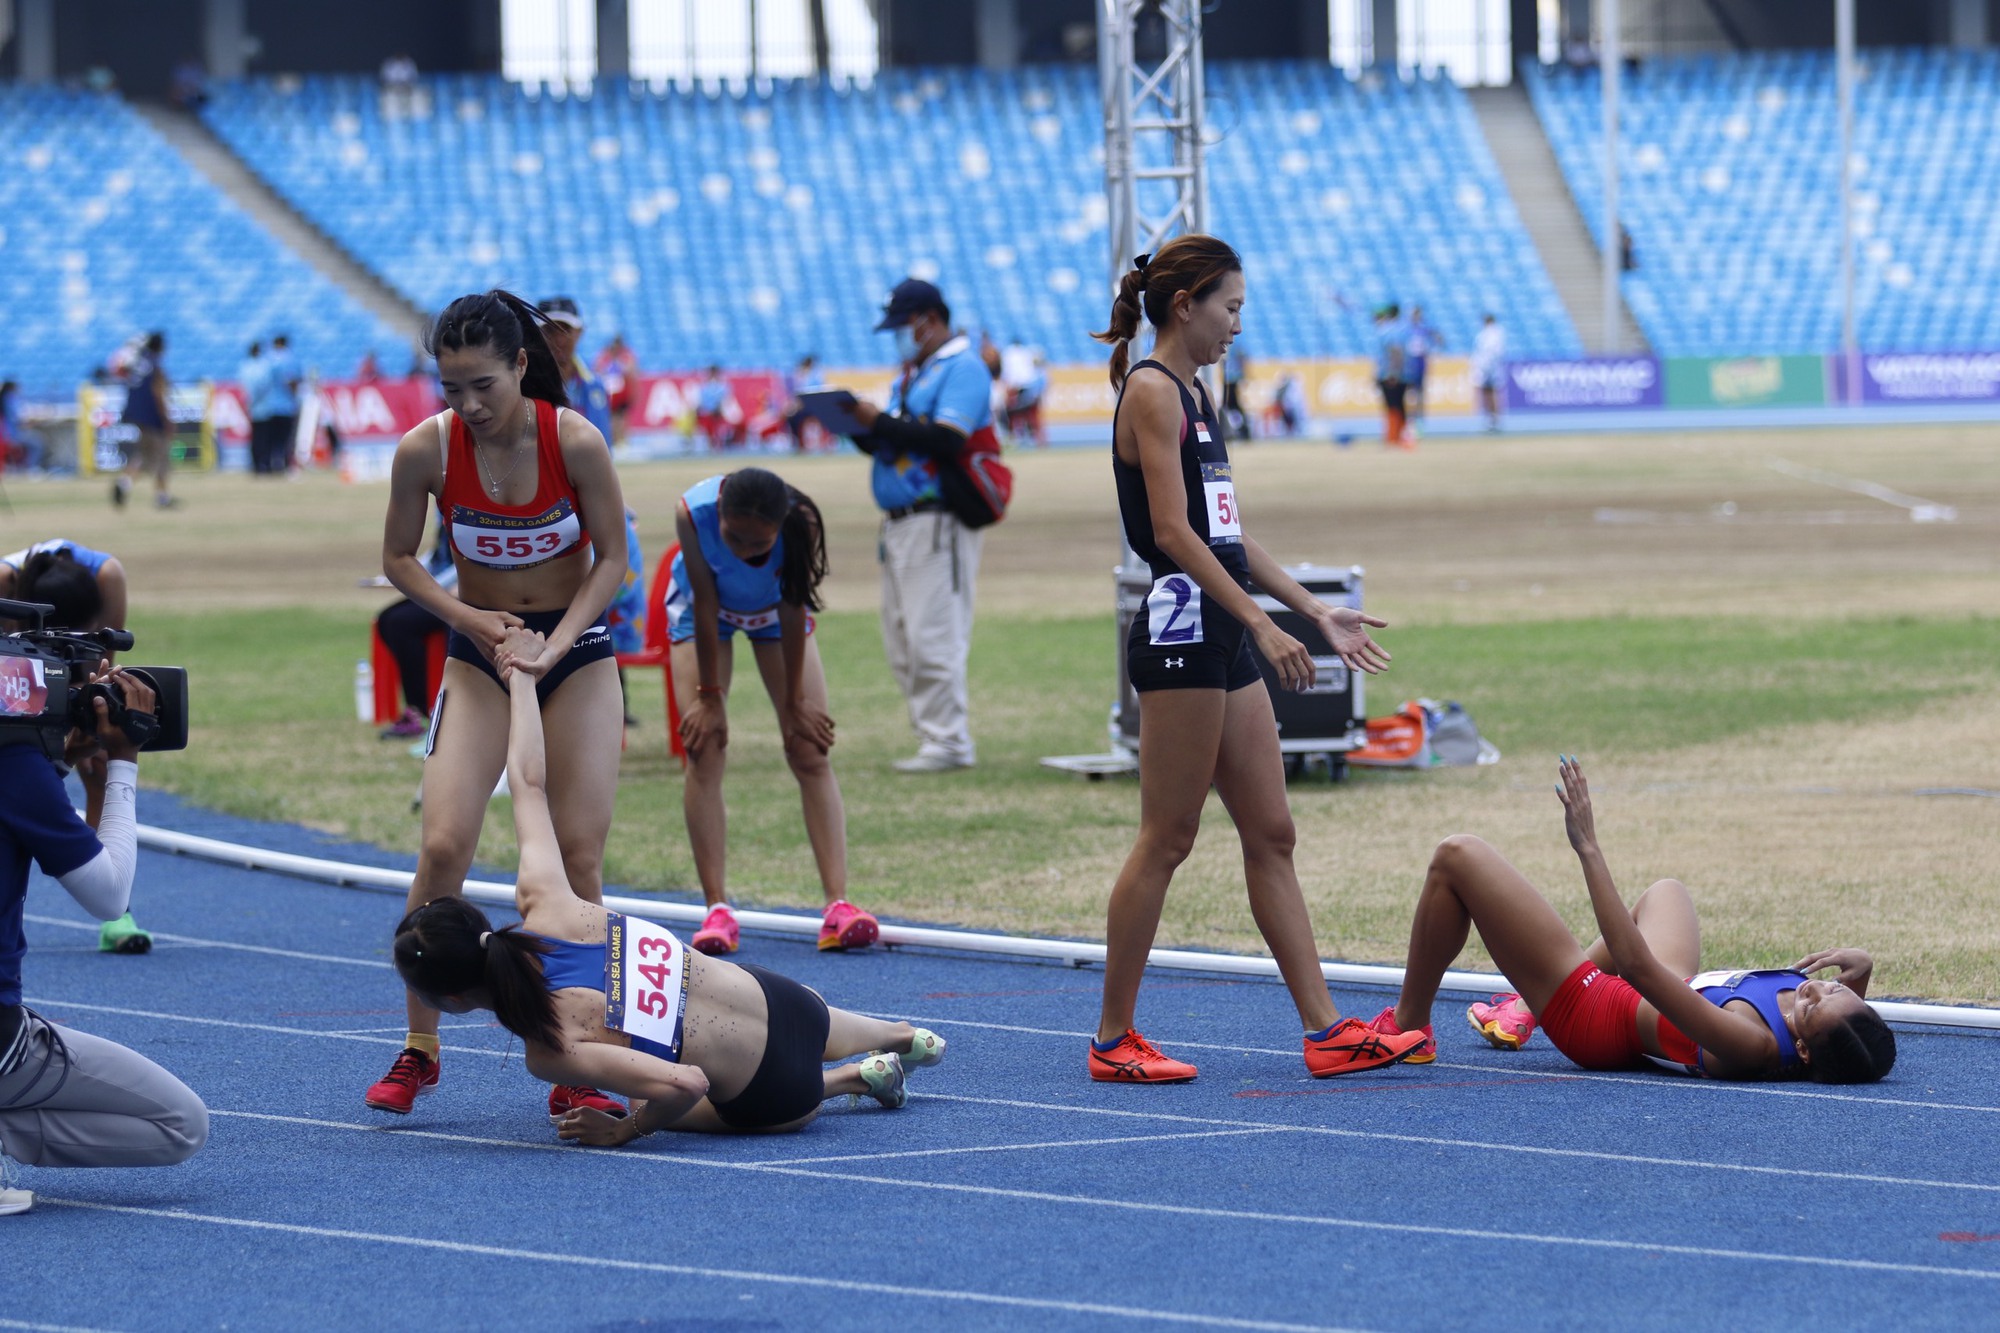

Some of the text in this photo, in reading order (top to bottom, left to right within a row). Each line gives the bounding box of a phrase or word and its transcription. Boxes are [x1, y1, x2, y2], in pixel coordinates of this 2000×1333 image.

[476, 532, 562, 558] 553
[479, 516, 502, 526] 32nd
[527, 509, 562, 526] GAMES
[1156, 577, 1197, 643] 2
[611, 925, 622, 1002] 32nd SEA GAMES
[637, 936, 672, 1020] 543
